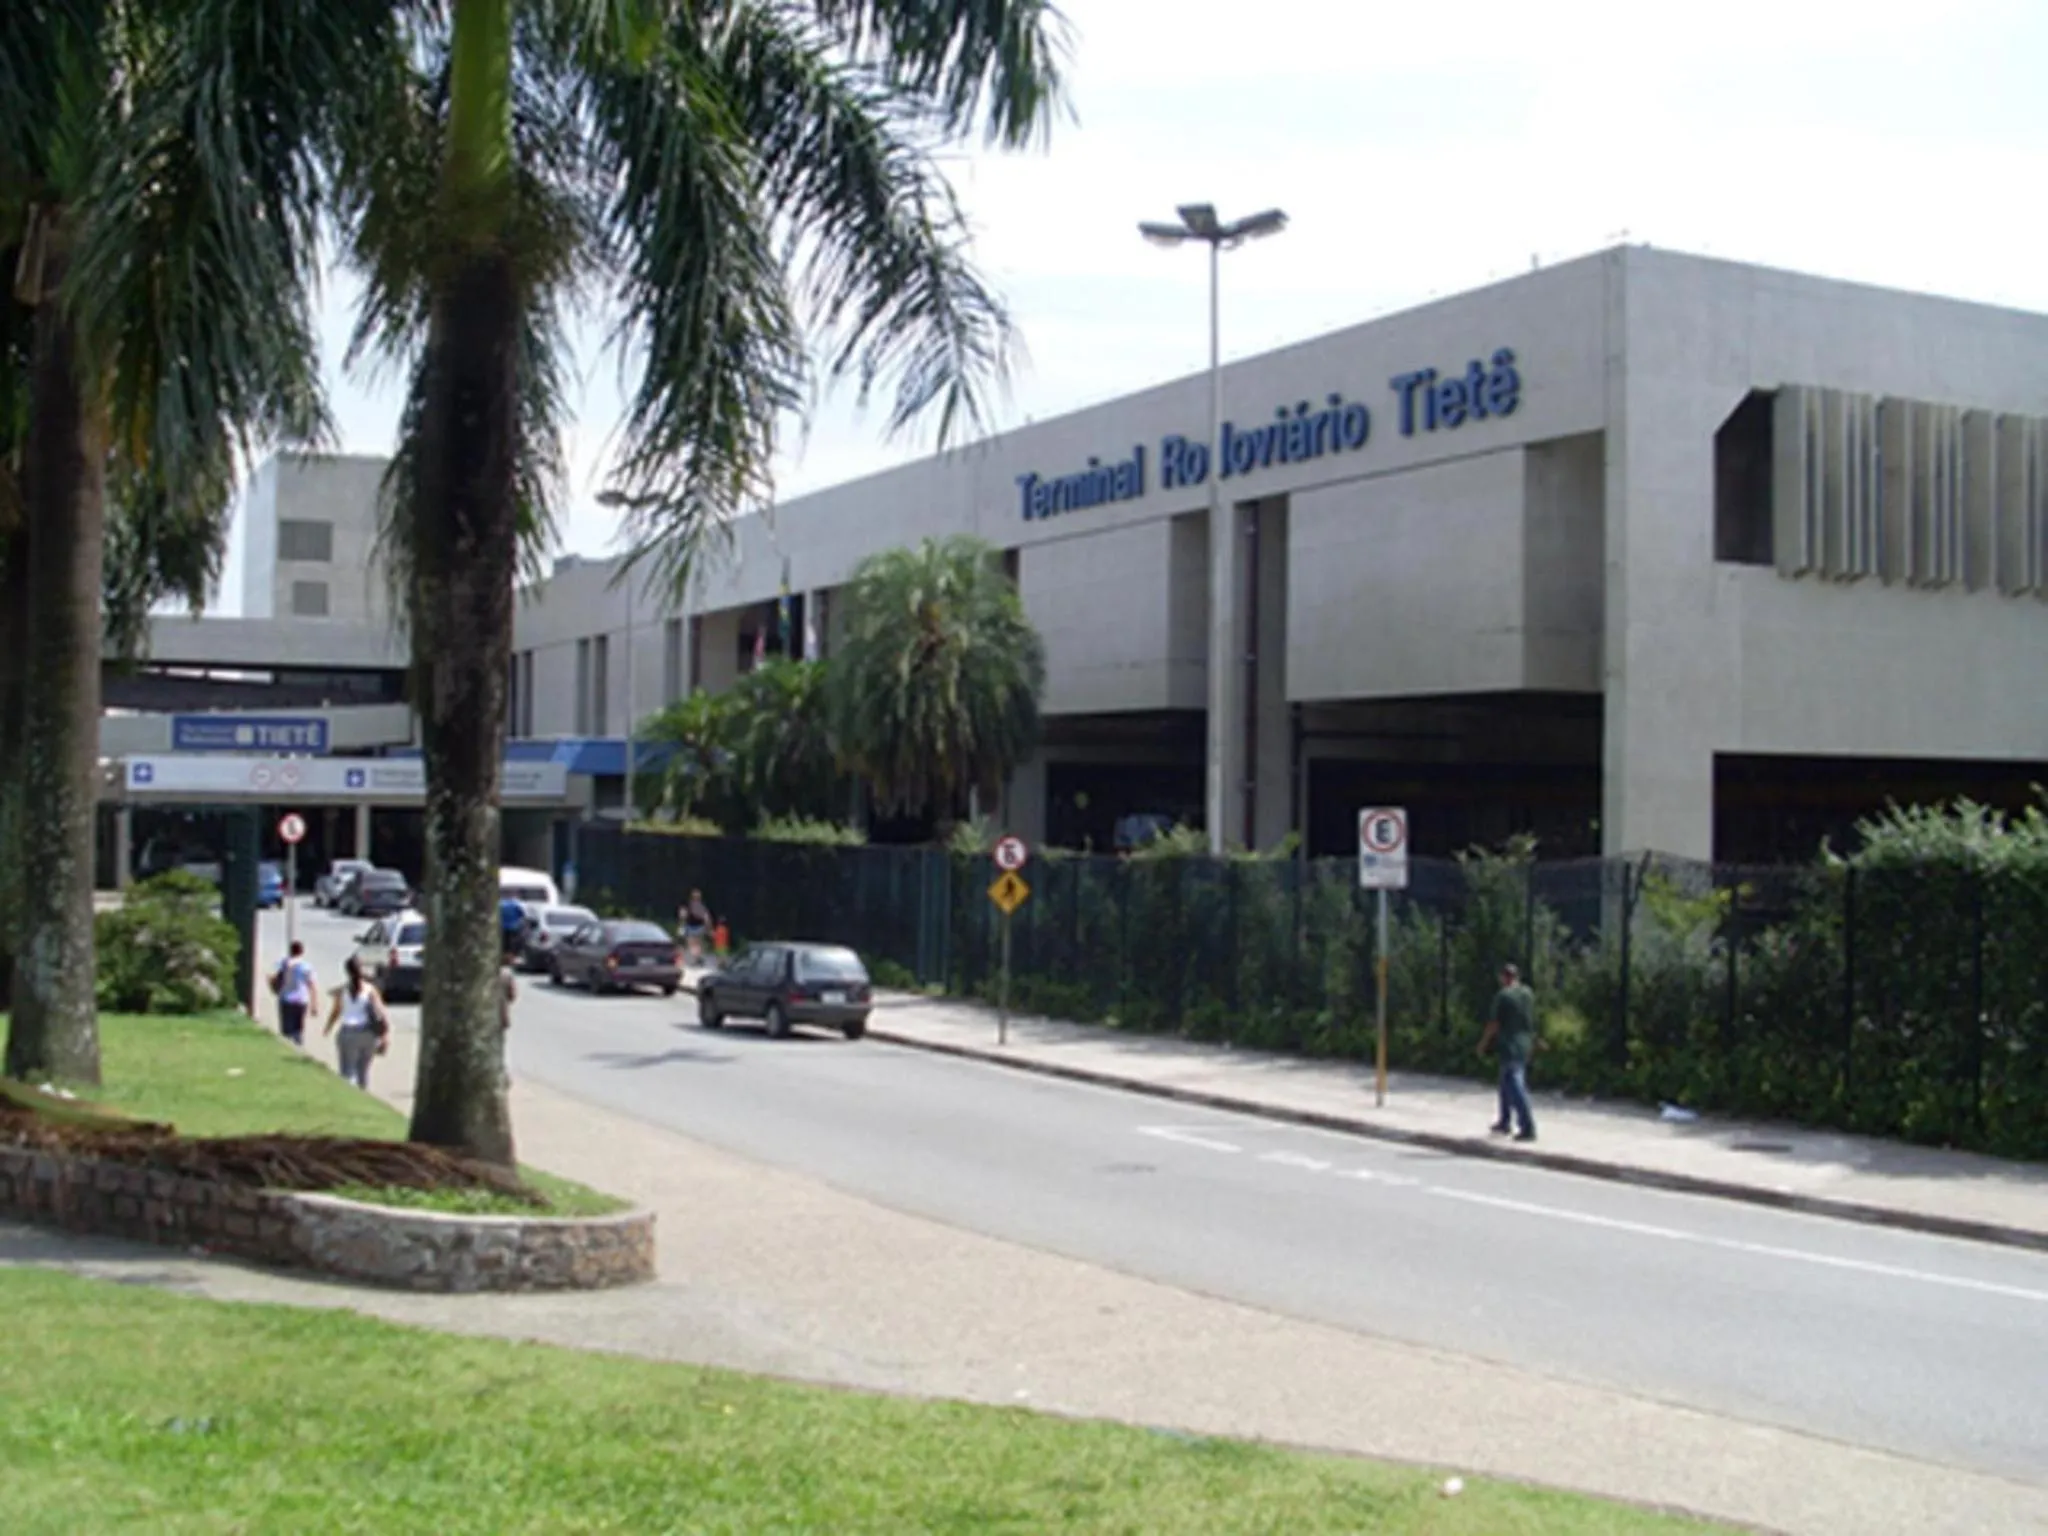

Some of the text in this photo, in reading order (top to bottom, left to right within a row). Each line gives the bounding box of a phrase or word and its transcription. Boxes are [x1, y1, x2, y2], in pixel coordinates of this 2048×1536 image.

[1015, 442, 1146, 521] Terminal
[1389, 347, 1520, 437] Tietê
[1375, 818, 1392, 844] E
